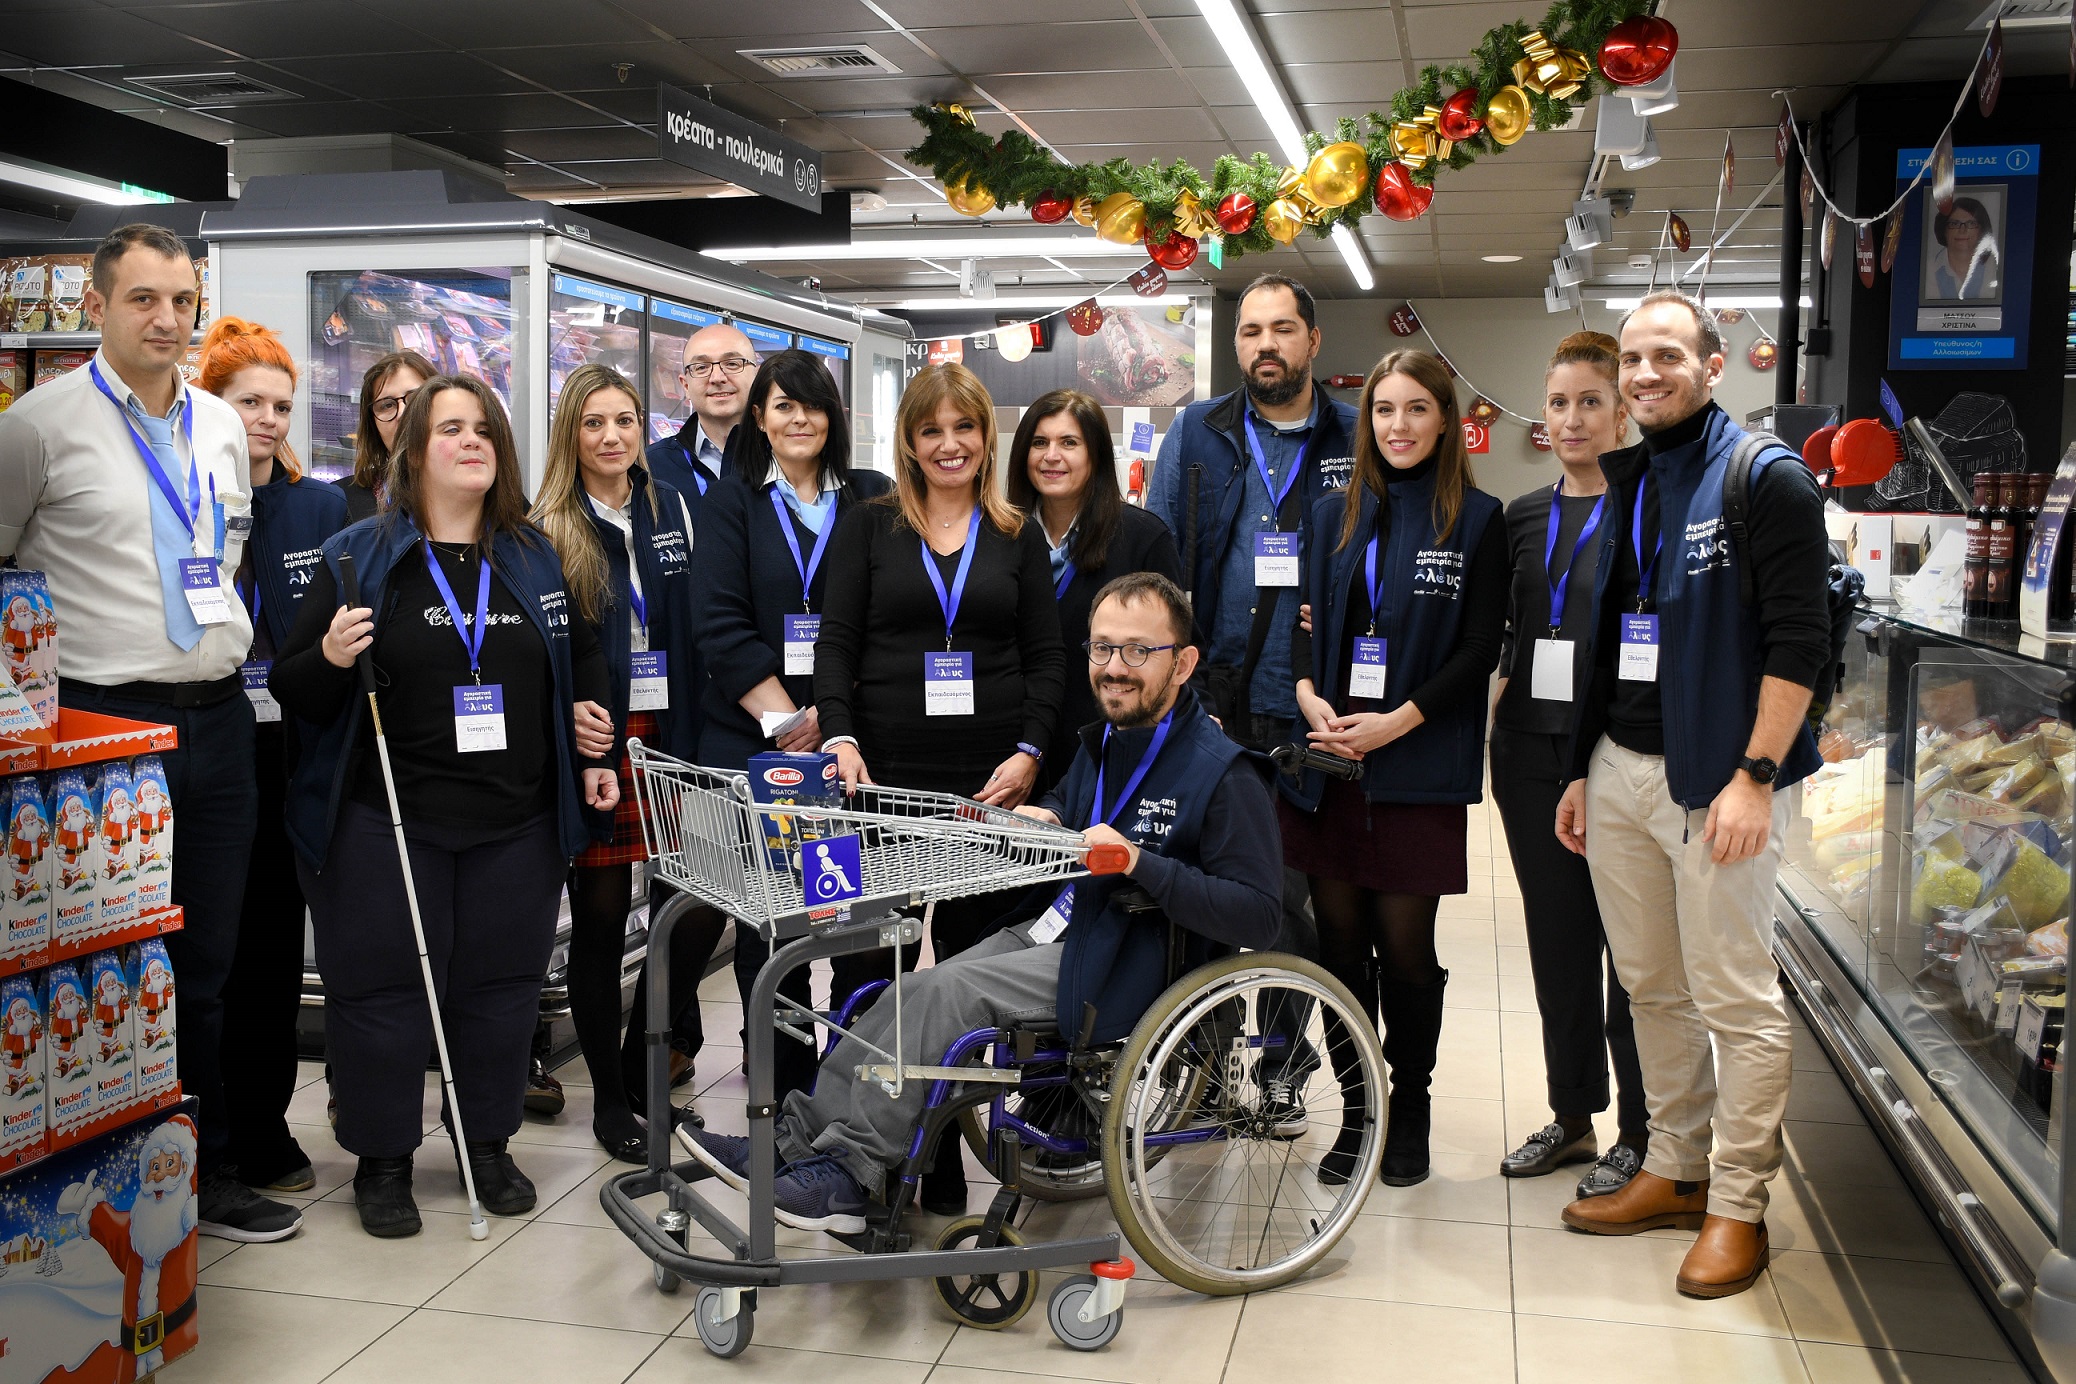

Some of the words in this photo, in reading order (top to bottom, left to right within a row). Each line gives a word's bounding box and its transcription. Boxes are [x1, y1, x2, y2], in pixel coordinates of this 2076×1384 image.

[667, 110, 714, 150] κρέατα
[726, 136, 784, 178] πουλερικά
[1977, 156, 1998, 165] ΣΑΣ
[1933, 340, 1982, 348] Υπεύθυνος/η
[773, 771, 801, 781] Barilla
[770, 788, 799, 796] RIGATONI
[101, 893, 128, 908] Kinder
[57, 905, 86, 919] Kinder
[101, 902, 135, 919] CHOCOLATE
[9, 915, 38, 931] Kinder
[57, 914, 93, 930] CHOCOLATE
[8, 924, 46, 942] CHOCOLATE
[141, 1061, 166, 1077] Kinder
[98, 1076, 125, 1092] Kinder
[140, 1069, 173, 1087] CHOCOLATE
[55, 1091, 83, 1108] Kinder
[98, 1083, 132, 1102] CHOCOLATE
[55, 1099, 91, 1118] CHOCOLATE
[3, 1110, 33, 1127] Kinder
[3, 1116, 41, 1138] CHOCOLATE
